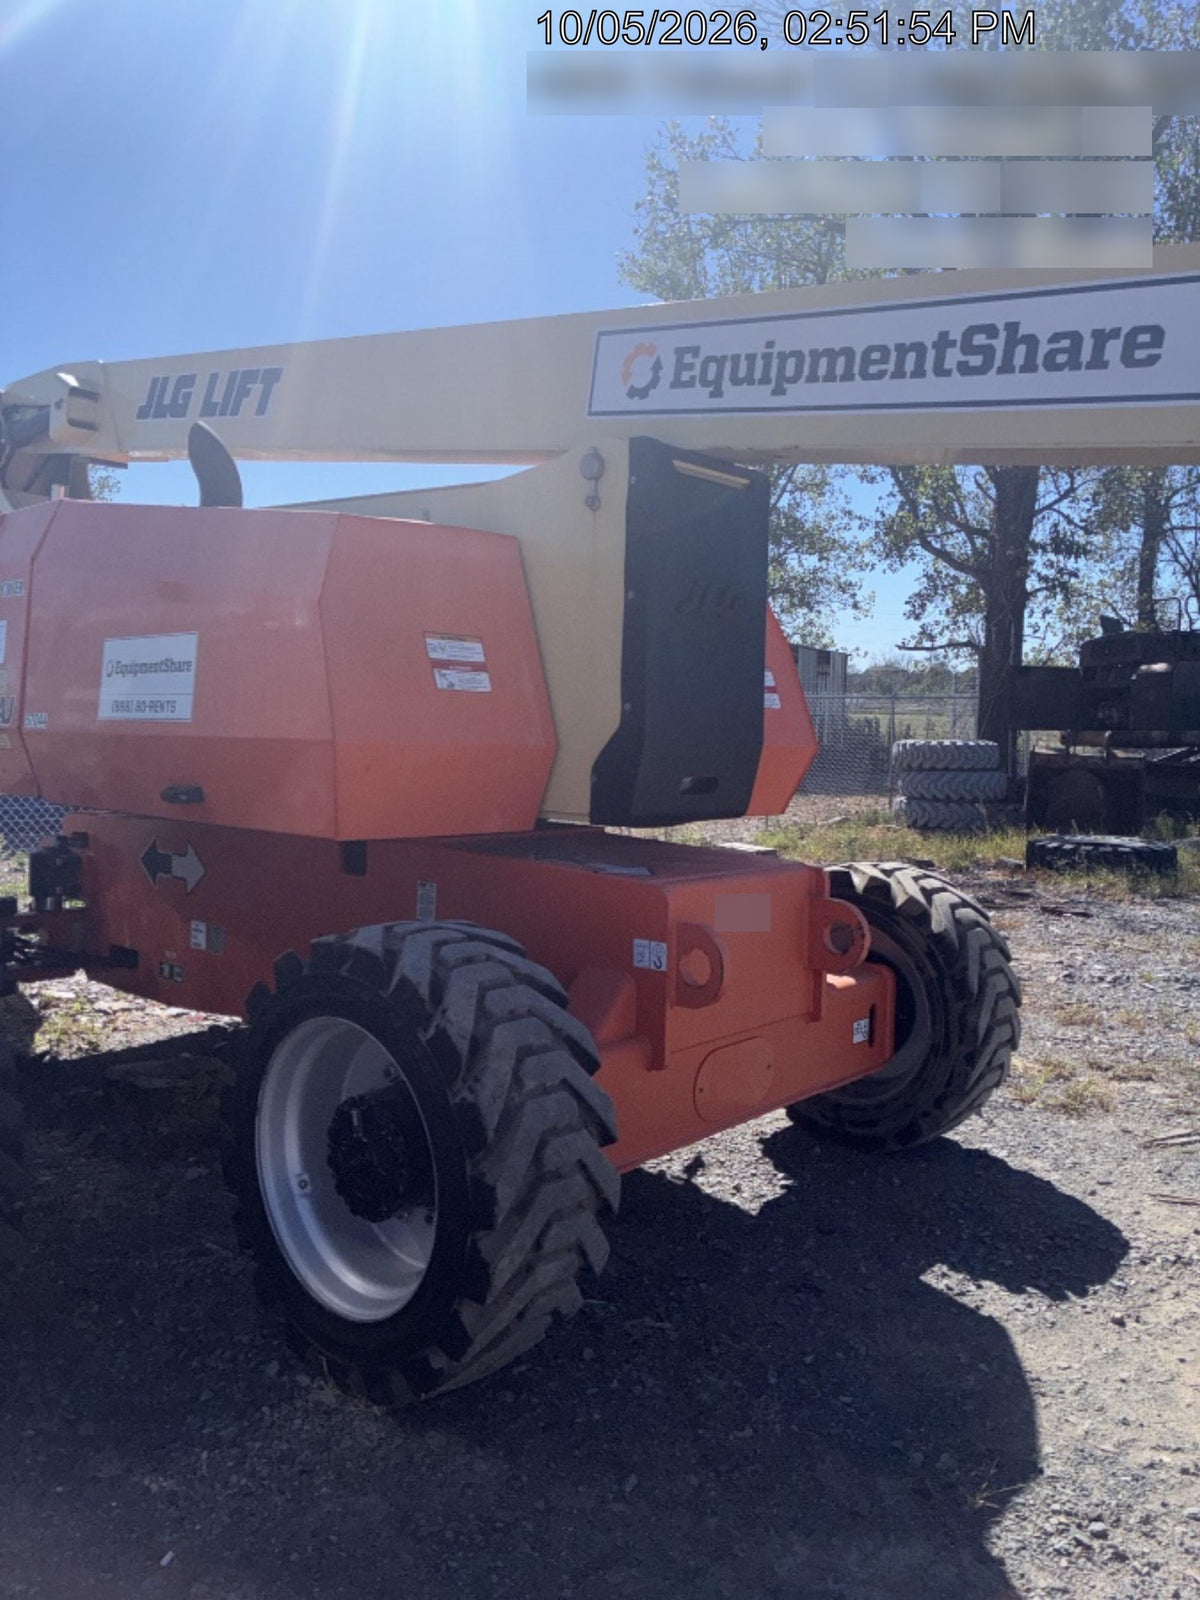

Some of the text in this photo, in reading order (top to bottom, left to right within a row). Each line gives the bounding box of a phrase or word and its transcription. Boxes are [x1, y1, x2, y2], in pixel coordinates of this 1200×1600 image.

[669, 321, 1165, 398] EquipmentShare
[136, 367, 283, 420] JLG LIFT
[115, 658, 192, 677] EquipmentShare
